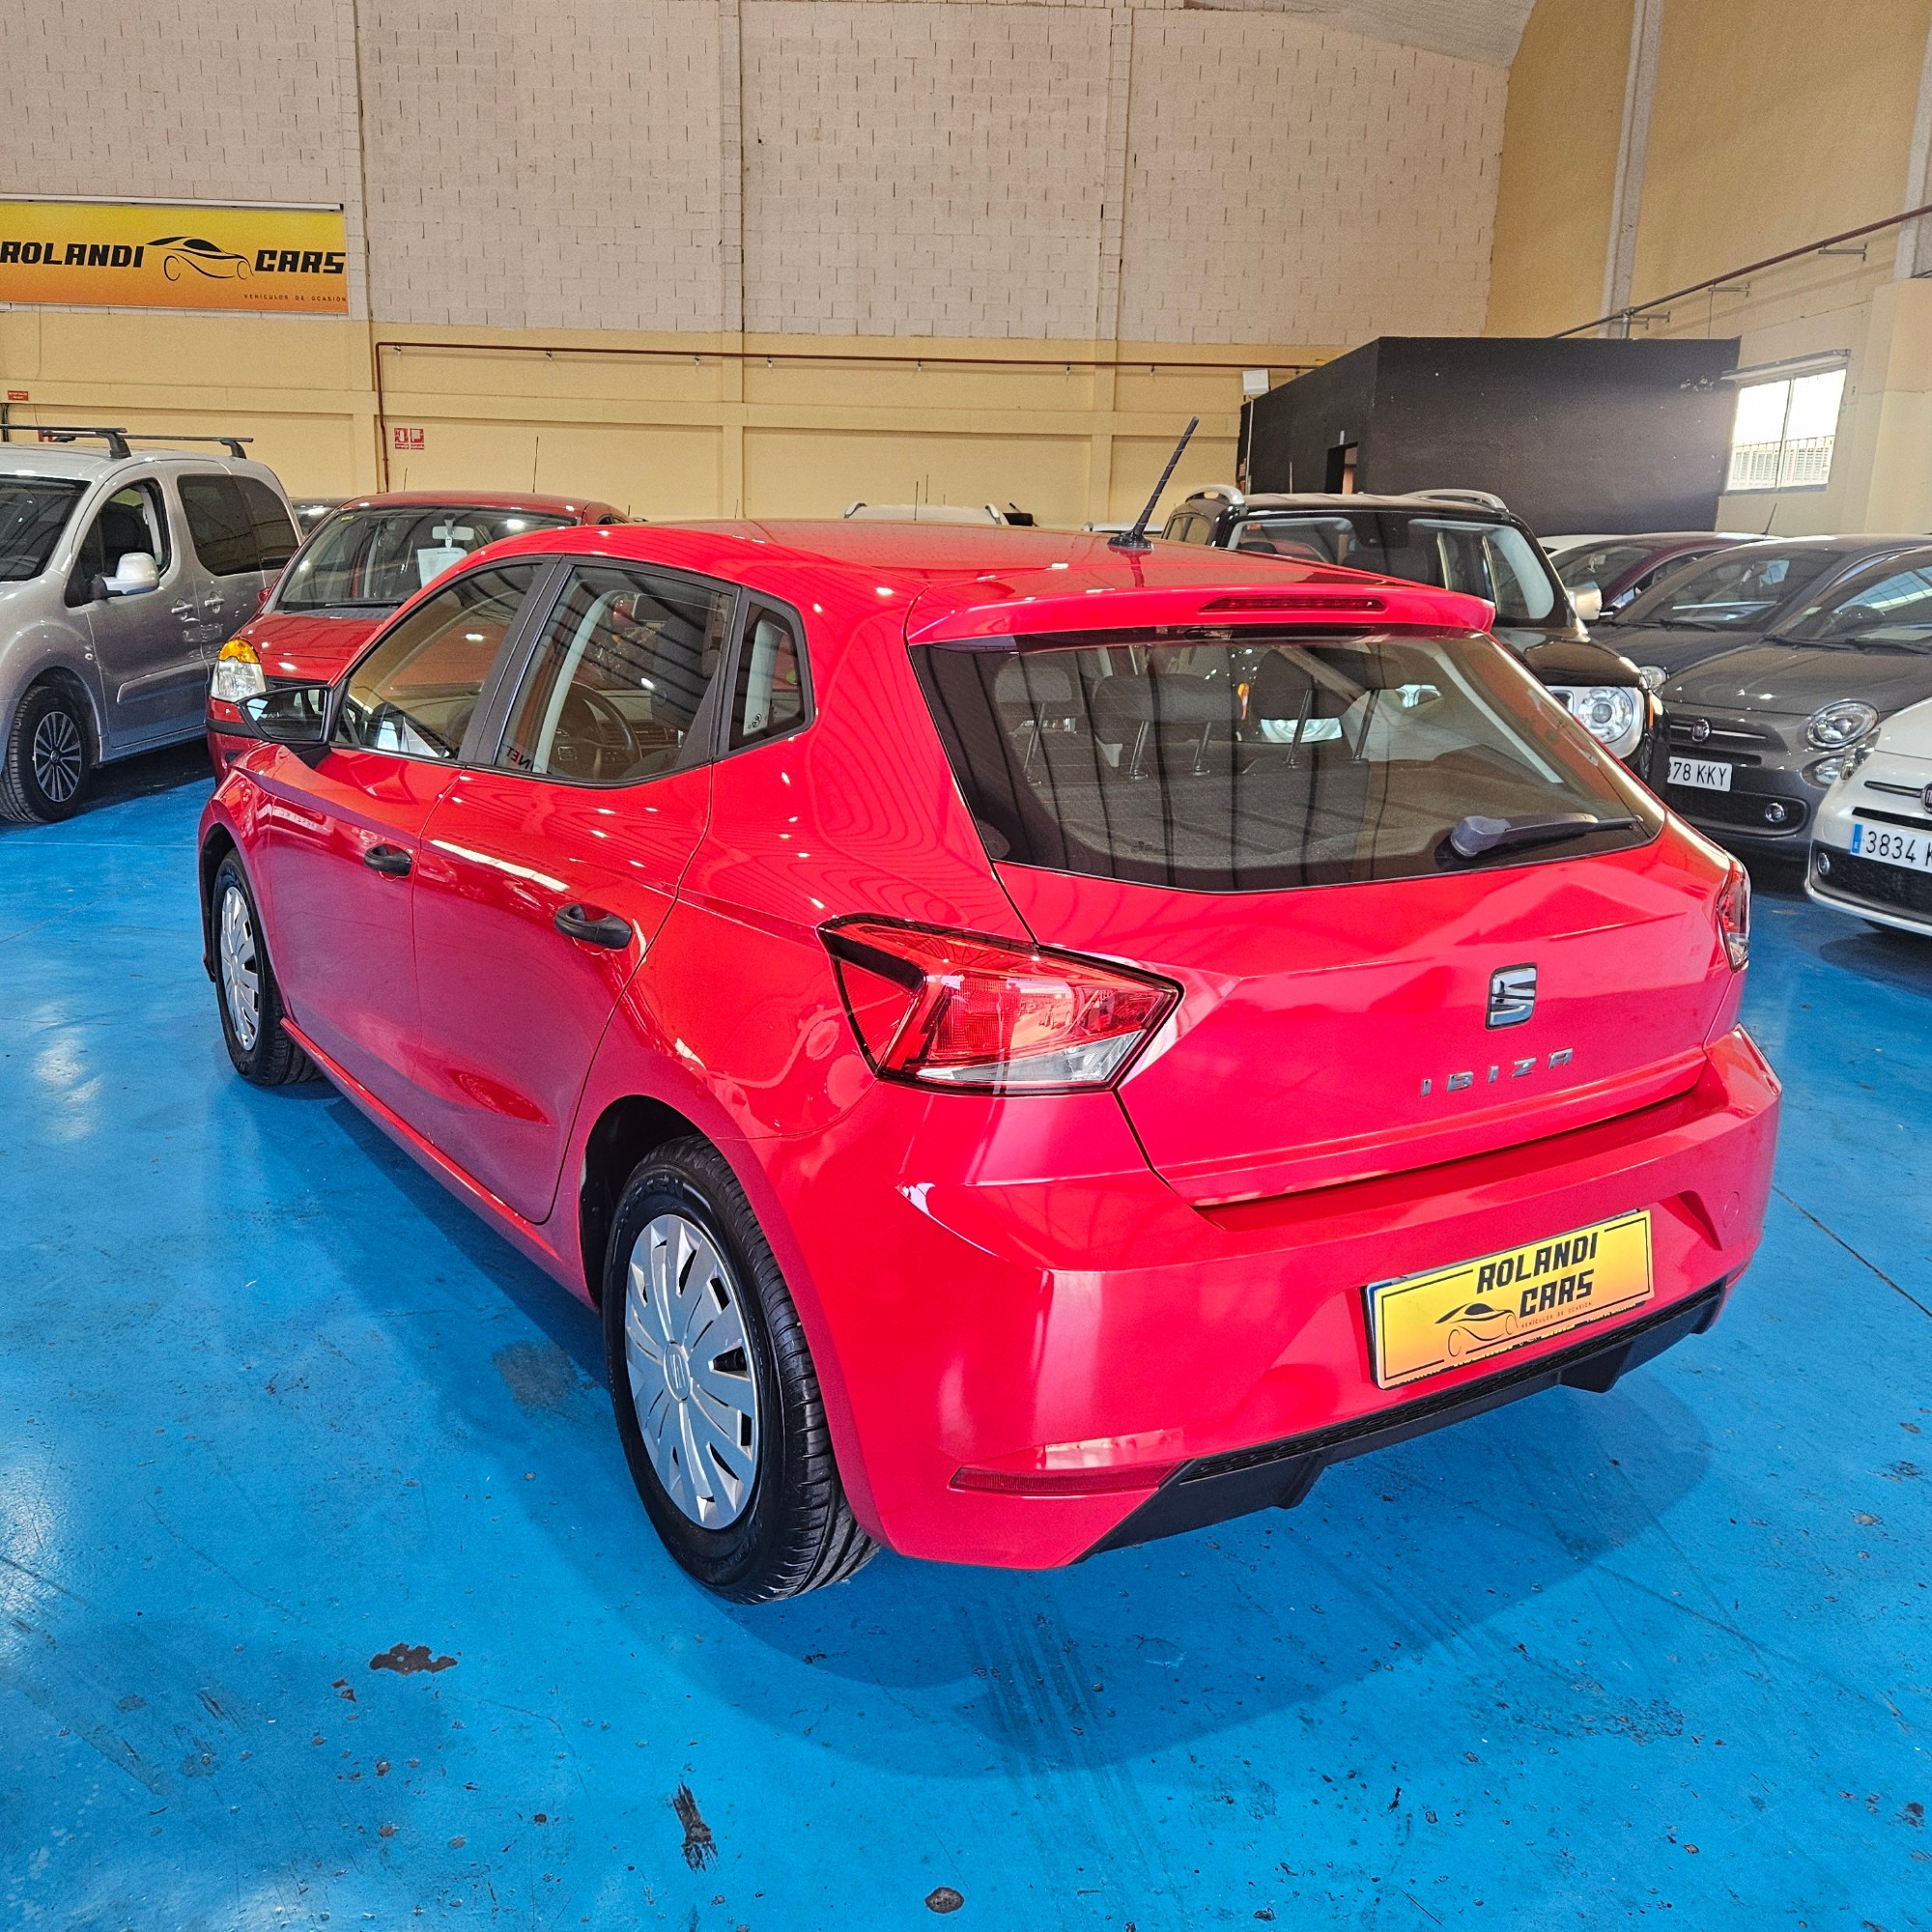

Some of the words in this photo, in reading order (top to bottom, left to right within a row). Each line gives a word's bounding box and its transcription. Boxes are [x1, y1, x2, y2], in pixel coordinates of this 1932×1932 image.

[0, 241, 144, 268] ROLANDI
[254, 249, 347, 274] CARS
[1668, 761, 1691, 781] 78
[1696, 763, 1727, 786] KKY
[1865, 831, 1917, 864] 3834
[1420, 1047, 1574, 1097] IBIZA
[1476, 1232, 1598, 1294] ROLANDI
[1519, 1268, 1595, 1319] CARS
